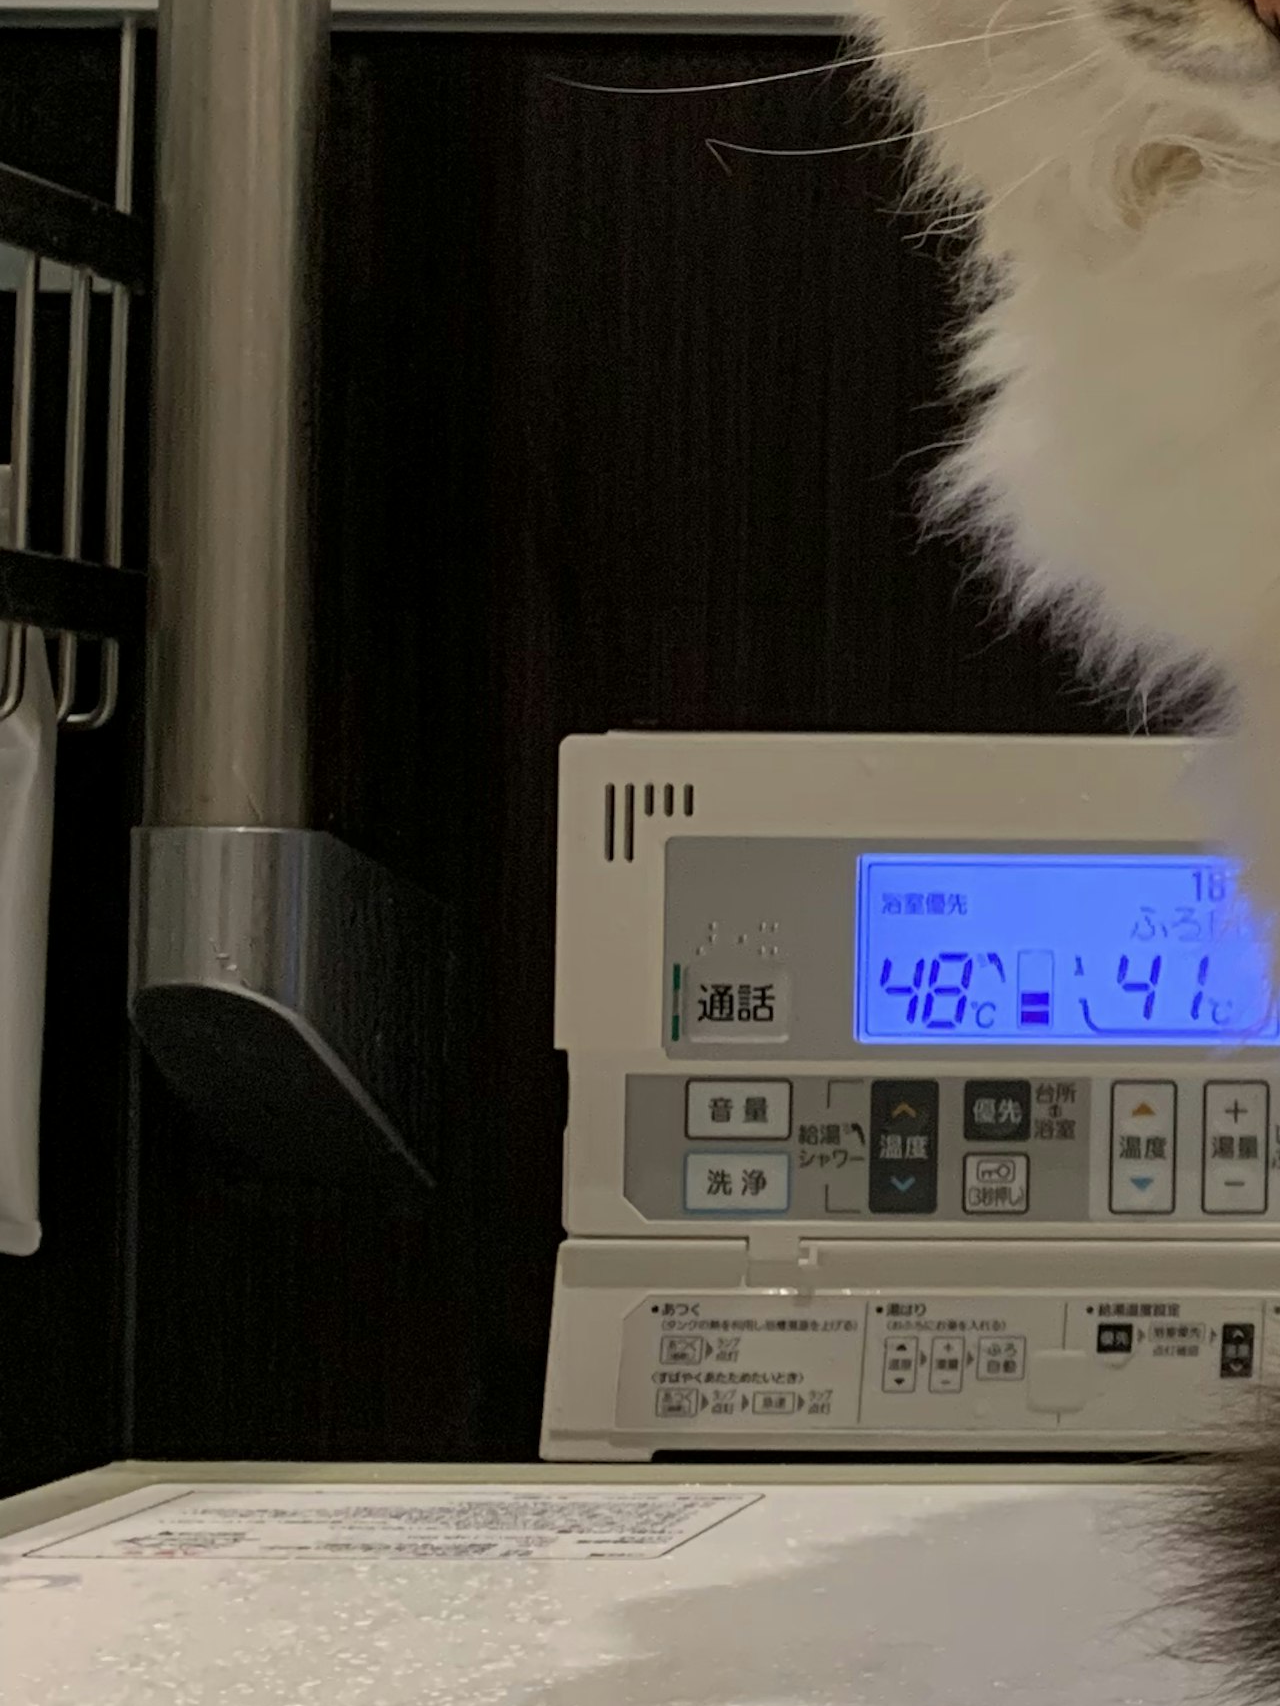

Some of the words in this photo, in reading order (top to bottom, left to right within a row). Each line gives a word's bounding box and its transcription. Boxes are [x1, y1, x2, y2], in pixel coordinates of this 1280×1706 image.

[881, 892, 967, 915] 浴室優先
[698, 984, 775, 1022] 通話
[1035, 1082, 1076, 1103] 台所
[709, 1096, 768, 1123] 音量
[973, 1098, 1022, 1123] 優先
[1034, 1119, 1075, 1140] 浴室
[800, 1149, 865, 1169] シャワー
[880, 1135, 928, 1160] 温度
[1119, 1135, 1167, 1160] 温度
[1211, 1135, 1258, 1159] 湯量
[707, 1169, 767, 1196] 洗浄
[662, 1303, 700, 1316] あつく
